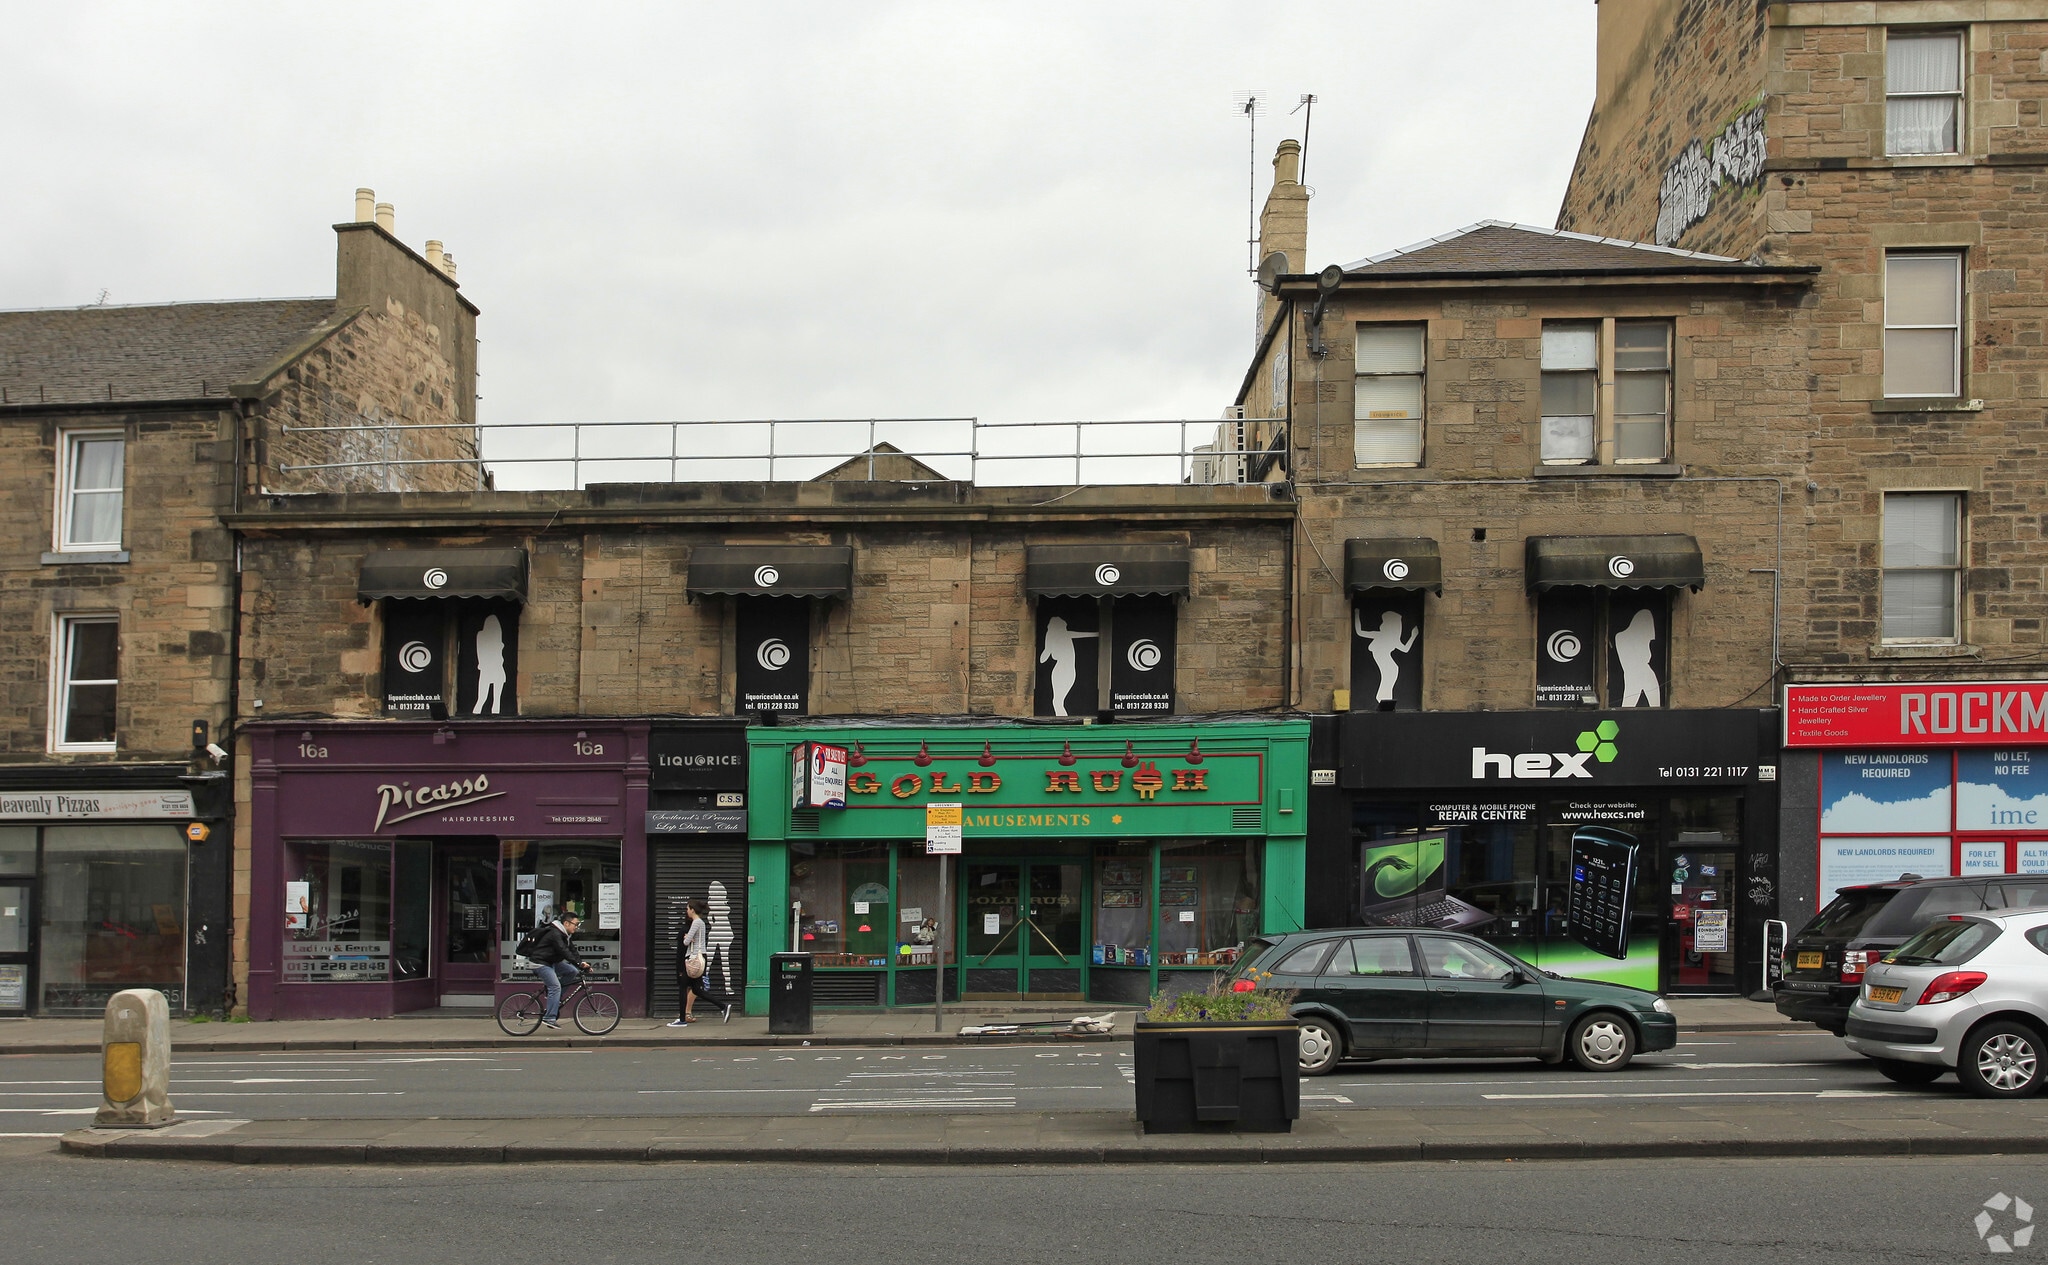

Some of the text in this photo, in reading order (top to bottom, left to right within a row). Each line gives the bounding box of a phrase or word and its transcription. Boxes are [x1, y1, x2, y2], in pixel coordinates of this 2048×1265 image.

[388, 694, 441, 702] liquoriceclub.co.uk
[745, 693, 799, 701] liquoriceclub.co.uk
[1114, 693, 1169, 701] liquoriceclub.co.uk
[1830, 694, 1850, 702] Order
[1852, 693, 1887, 704] Jewellery
[745, 702, 799, 710] tel. 0131 228 9330
[1114, 702, 1169, 710] tel. 0131 228 9330
[1798, 705, 1868, 714] Hand Crafted Silver
[1798, 716, 1832, 726] Jewellery
[1798, 728, 1849, 736] Textile Goods
[298, 744, 328, 758] 16a
[573, 742, 604, 755] 16a
[1844, 754, 1928, 764] NEW LANDLORDS
[1994, 752, 2030, 763] NO LET,
[1472, 747, 1593, 779] hex
[1659, 766, 1749, 777] Tel 0131 221 1117
[1862, 768, 1910, 778] REQUIRED
[1995, 766, 2029, 775] NO FEE
[848, 771, 1003, 798] GOLD
[374, 774, 490, 833] Picasso
[719, 795, 741, 803] C.S.S
[57, 796, 100, 812] Pizzas
[652, 813, 742, 821] Scotland's Premier
[1439, 810, 1526, 820] REPAIR CENTRE
[1562, 810, 1644, 819] www.hexcs.net
[1990, 804, 2038, 825] ime
[962, 815, 1091, 827] AMUSEMENTS
[655, 822, 738, 831] Lap Dance Club
[1854, 848, 1897, 856] LANDLORDS
[1898, 848, 1935, 856] REQUIRED!
[334, 944, 343, 952] &
[346, 944, 380, 952] Gents
[287, 962, 385, 971] 0131 228 2848
